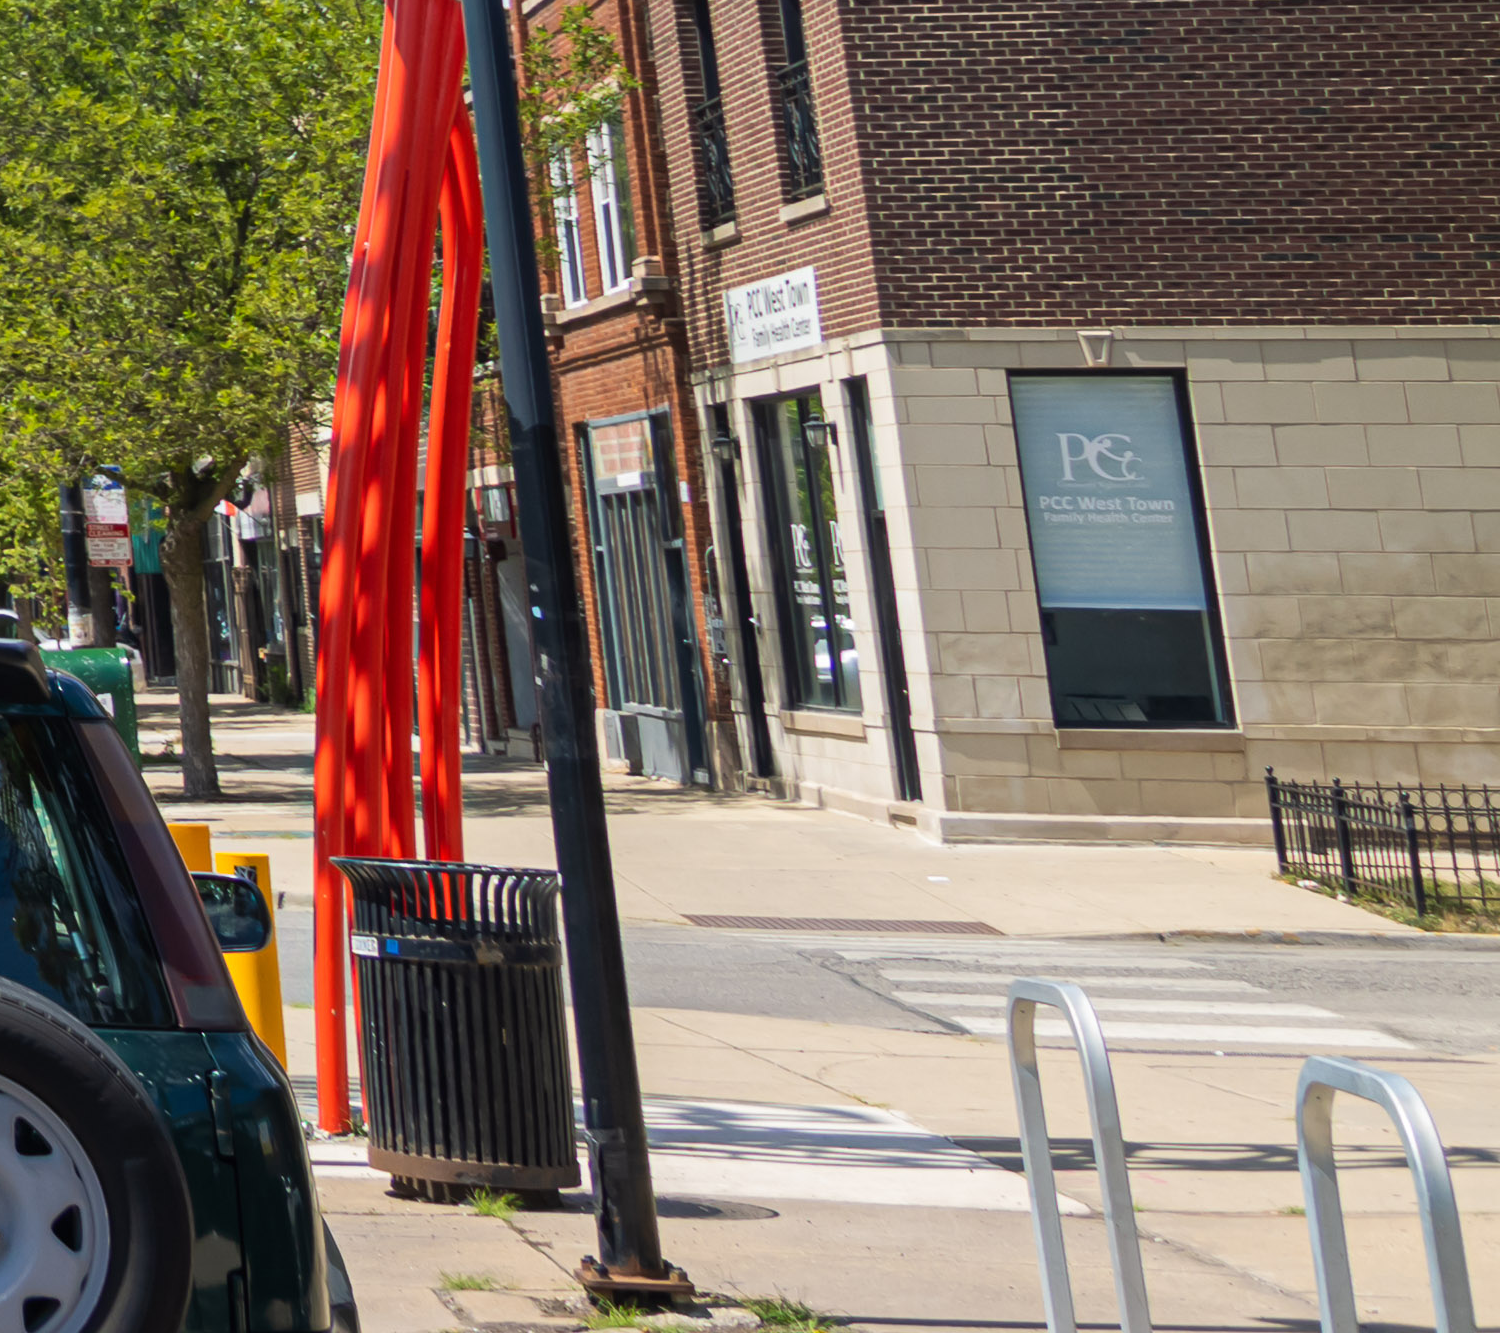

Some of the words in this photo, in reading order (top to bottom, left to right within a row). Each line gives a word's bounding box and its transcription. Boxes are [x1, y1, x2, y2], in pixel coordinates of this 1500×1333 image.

[746, 289, 764, 320] PCC
[761, 284, 786, 315] West
[785, 279, 811, 309] Town
[1039, 495, 1074, 510] PCC
[1076, 496, 1122, 511] West
[1125, 496, 1175, 511] Town
[1043, 511, 1085, 524] Family
[1088, 511, 1129, 523] Health
[1132, 513, 1173, 523] Center
